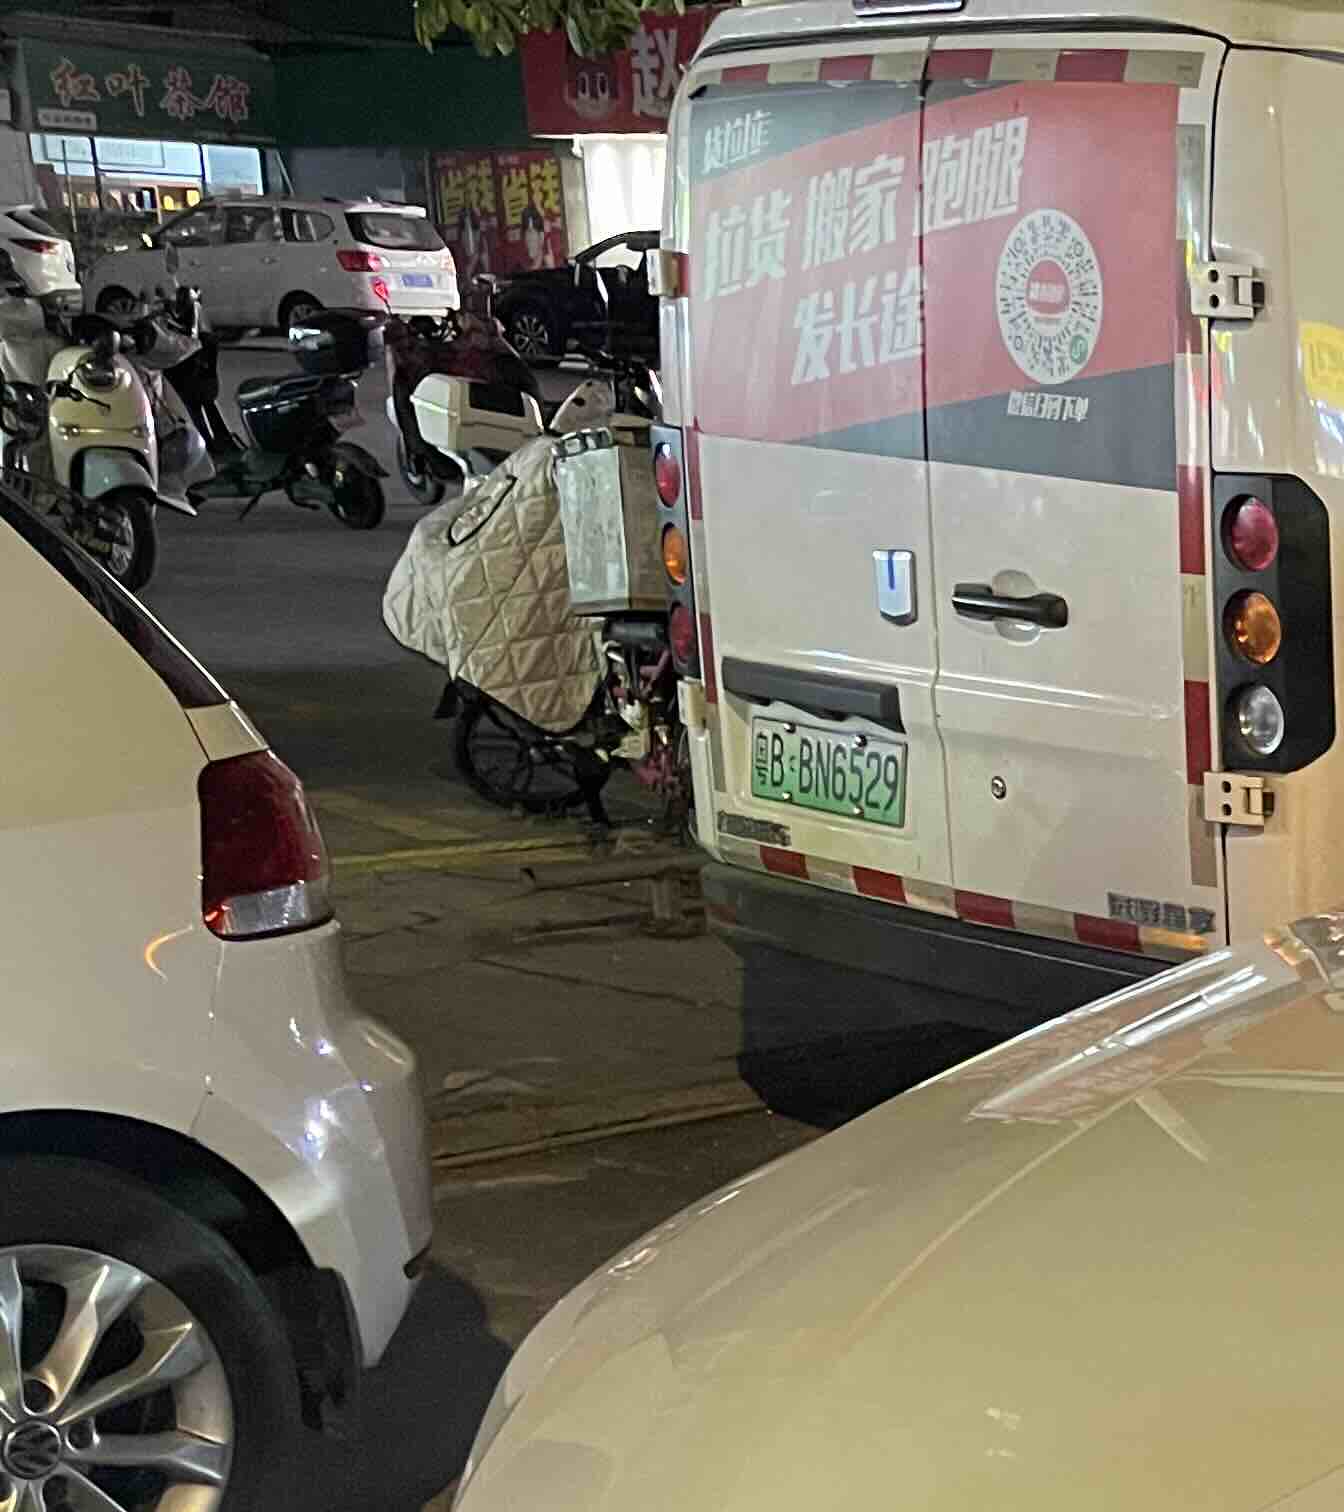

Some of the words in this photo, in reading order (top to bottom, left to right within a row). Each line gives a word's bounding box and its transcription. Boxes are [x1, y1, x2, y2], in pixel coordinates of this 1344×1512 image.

[704, 189, 792, 302] 拉货
[801, 154, 905, 271] 搬家
[912, 116, 1029, 237] 跑腿
[791, 262, 928, 385] 发长途
